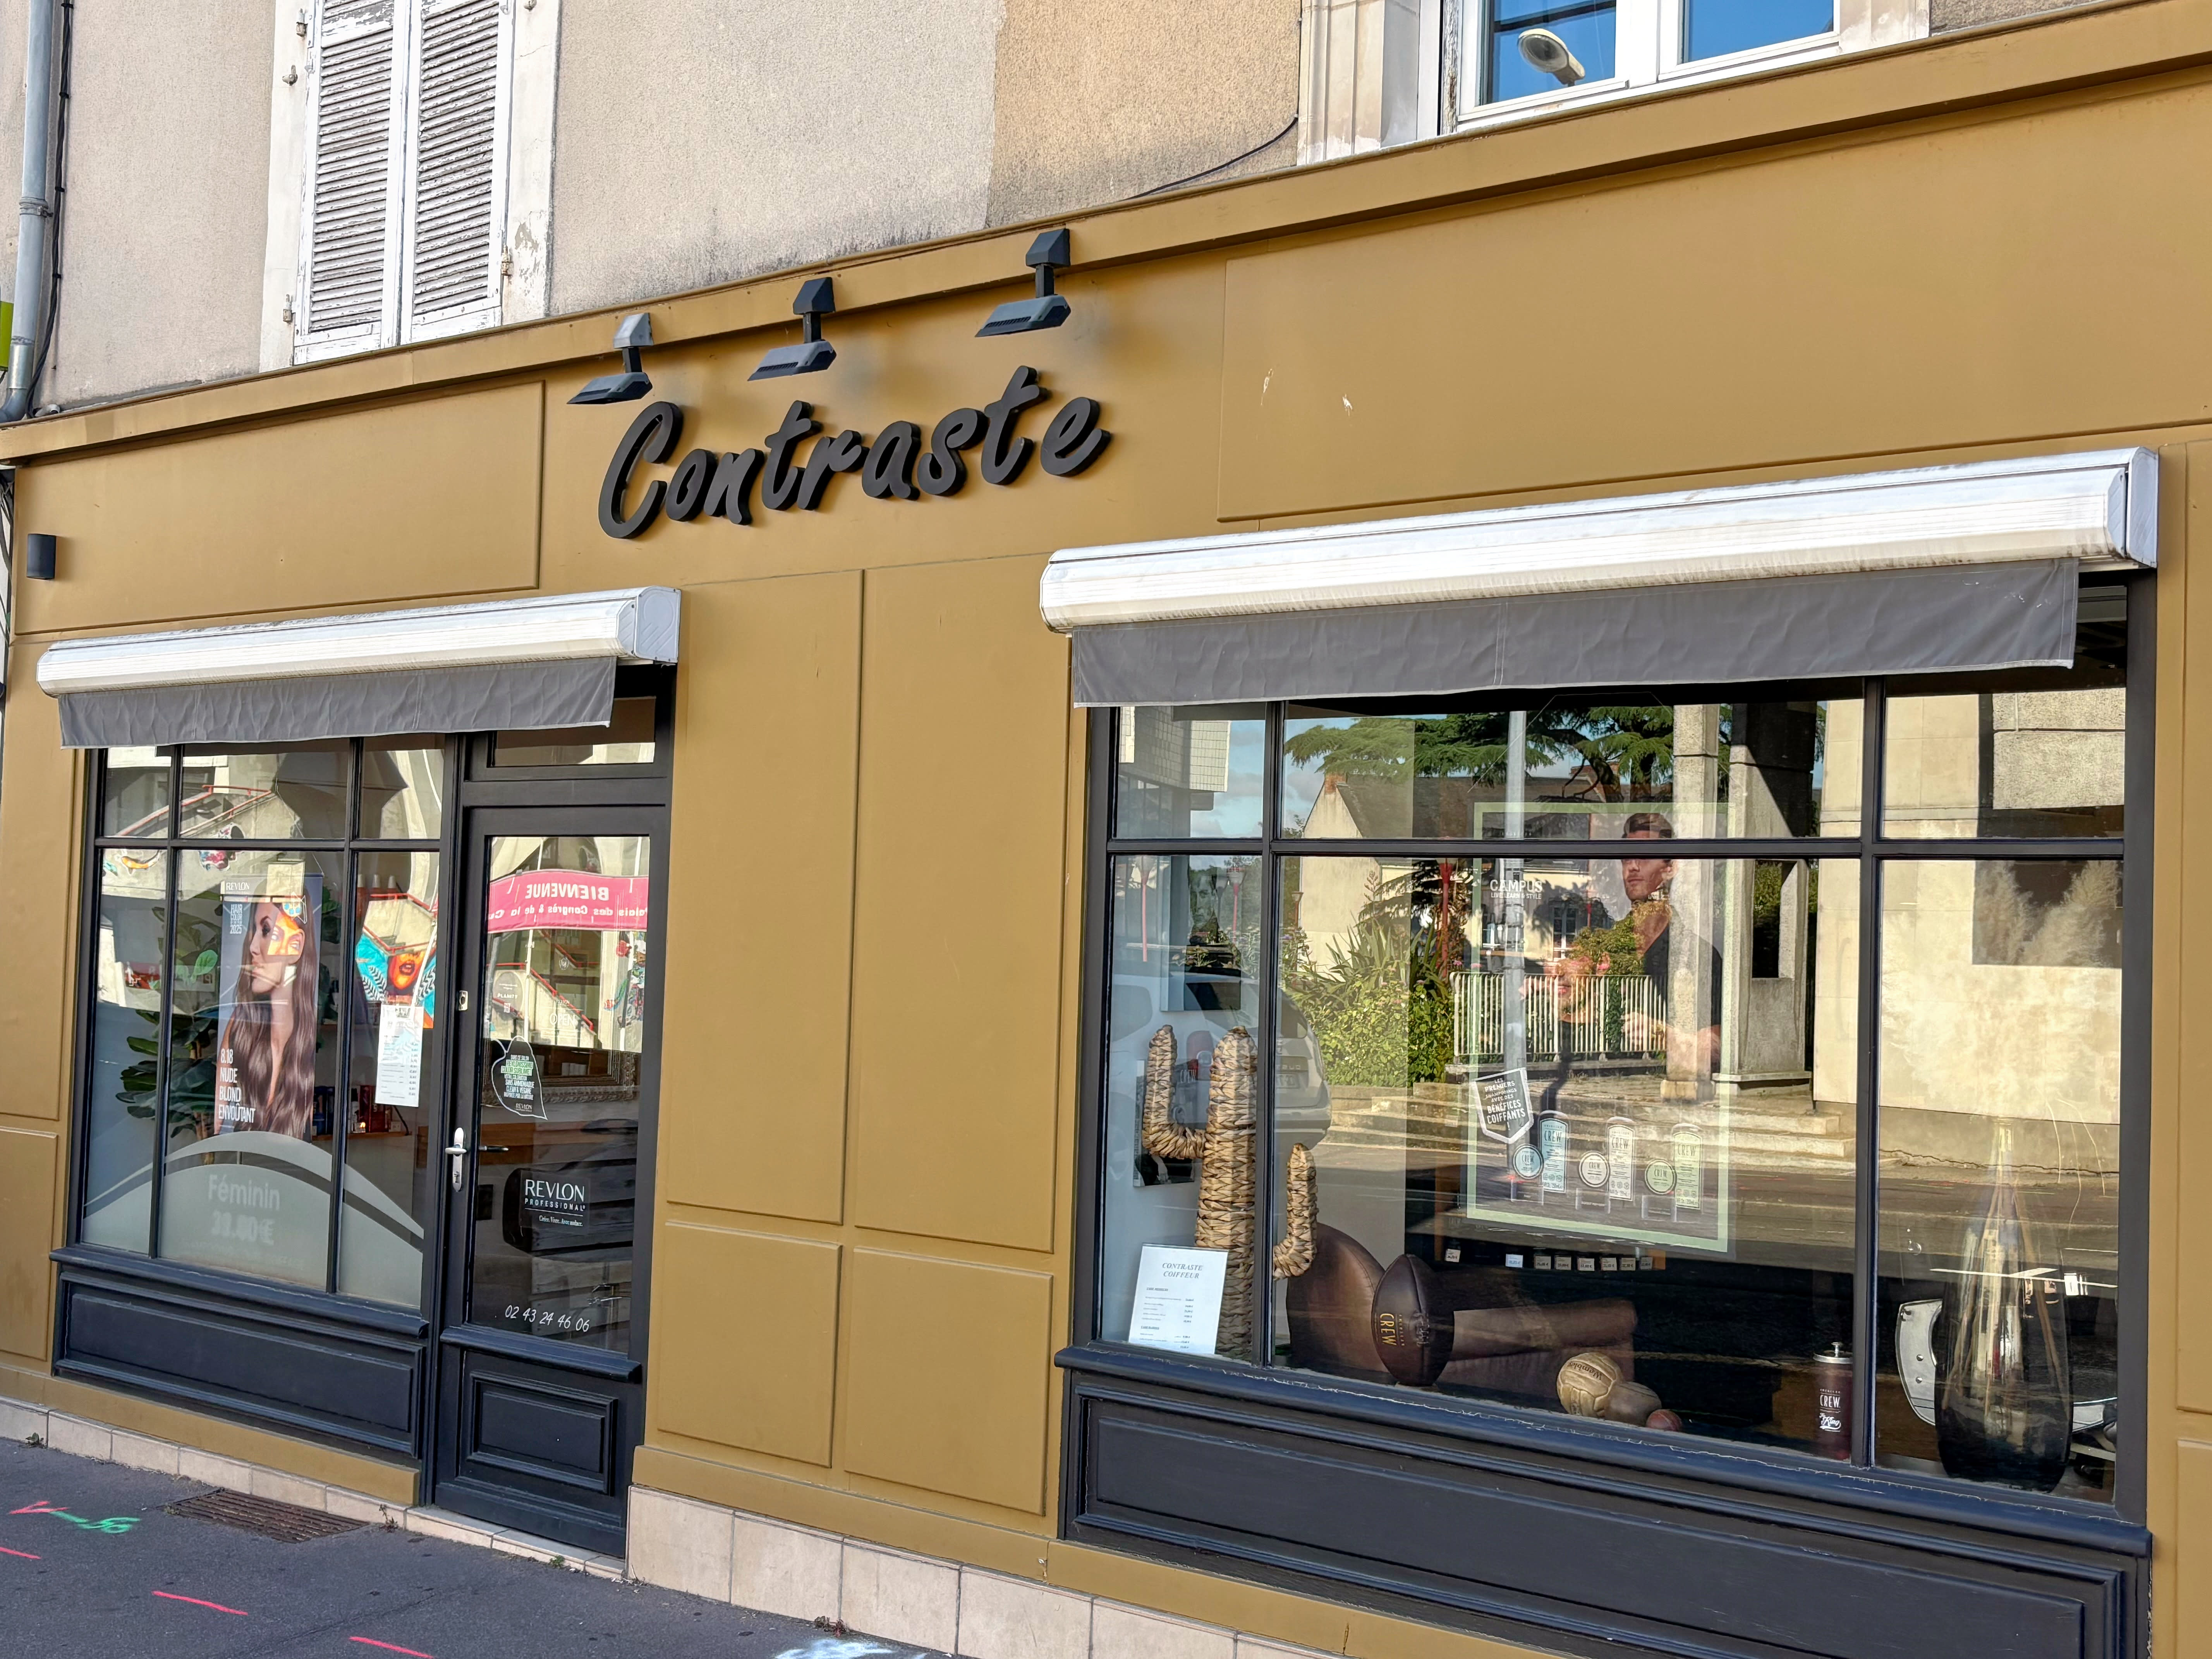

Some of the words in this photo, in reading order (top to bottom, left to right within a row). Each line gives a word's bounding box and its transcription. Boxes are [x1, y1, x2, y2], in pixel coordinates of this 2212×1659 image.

[598, 365, 1111, 539] Contraste
[226, 882, 250, 890] REVLON
[1490, 879, 1543, 893] CAMPUS
[231, 904, 242, 914] HAIR
[230, 924, 242, 934] 2025
[550, 1013, 576, 1026] OPEN
[221, 1048, 233, 1064] 8.18
[220, 1067, 238, 1083] NUDE
[1484, 1080, 1515, 1092] PREMIERS
[219, 1086, 241, 1102] BLOND
[218, 1103, 256, 1123] ENVOÛTANT
[1487, 1108, 1526, 1124] COIFFANTS
[1544, 1130, 1561, 1142] CREW
[1612, 1137, 1629, 1149] CREW
[1678, 1144, 1696, 1156] CREW
[1522, 1155, 1534, 1163] CREW
[1654, 1168, 1667, 1178] CREW
[208, 1174, 280, 1211] Féminin
[525, 1179, 585, 1202] REVLON
[1163, 1262, 1203, 1271] CONTRASTE
[505, 1305, 519, 1319] 02
[523, 1308, 537, 1322] 43
[539, 1312, 554, 1326] 24
[558, 1314, 571, 1329] 46
[576, 1318, 590, 1332] 06
[1380, 1313, 1397, 1345] CREW
[1820, 1395, 1840, 1408] CREW
[1821, 1416, 1840, 1427] King
